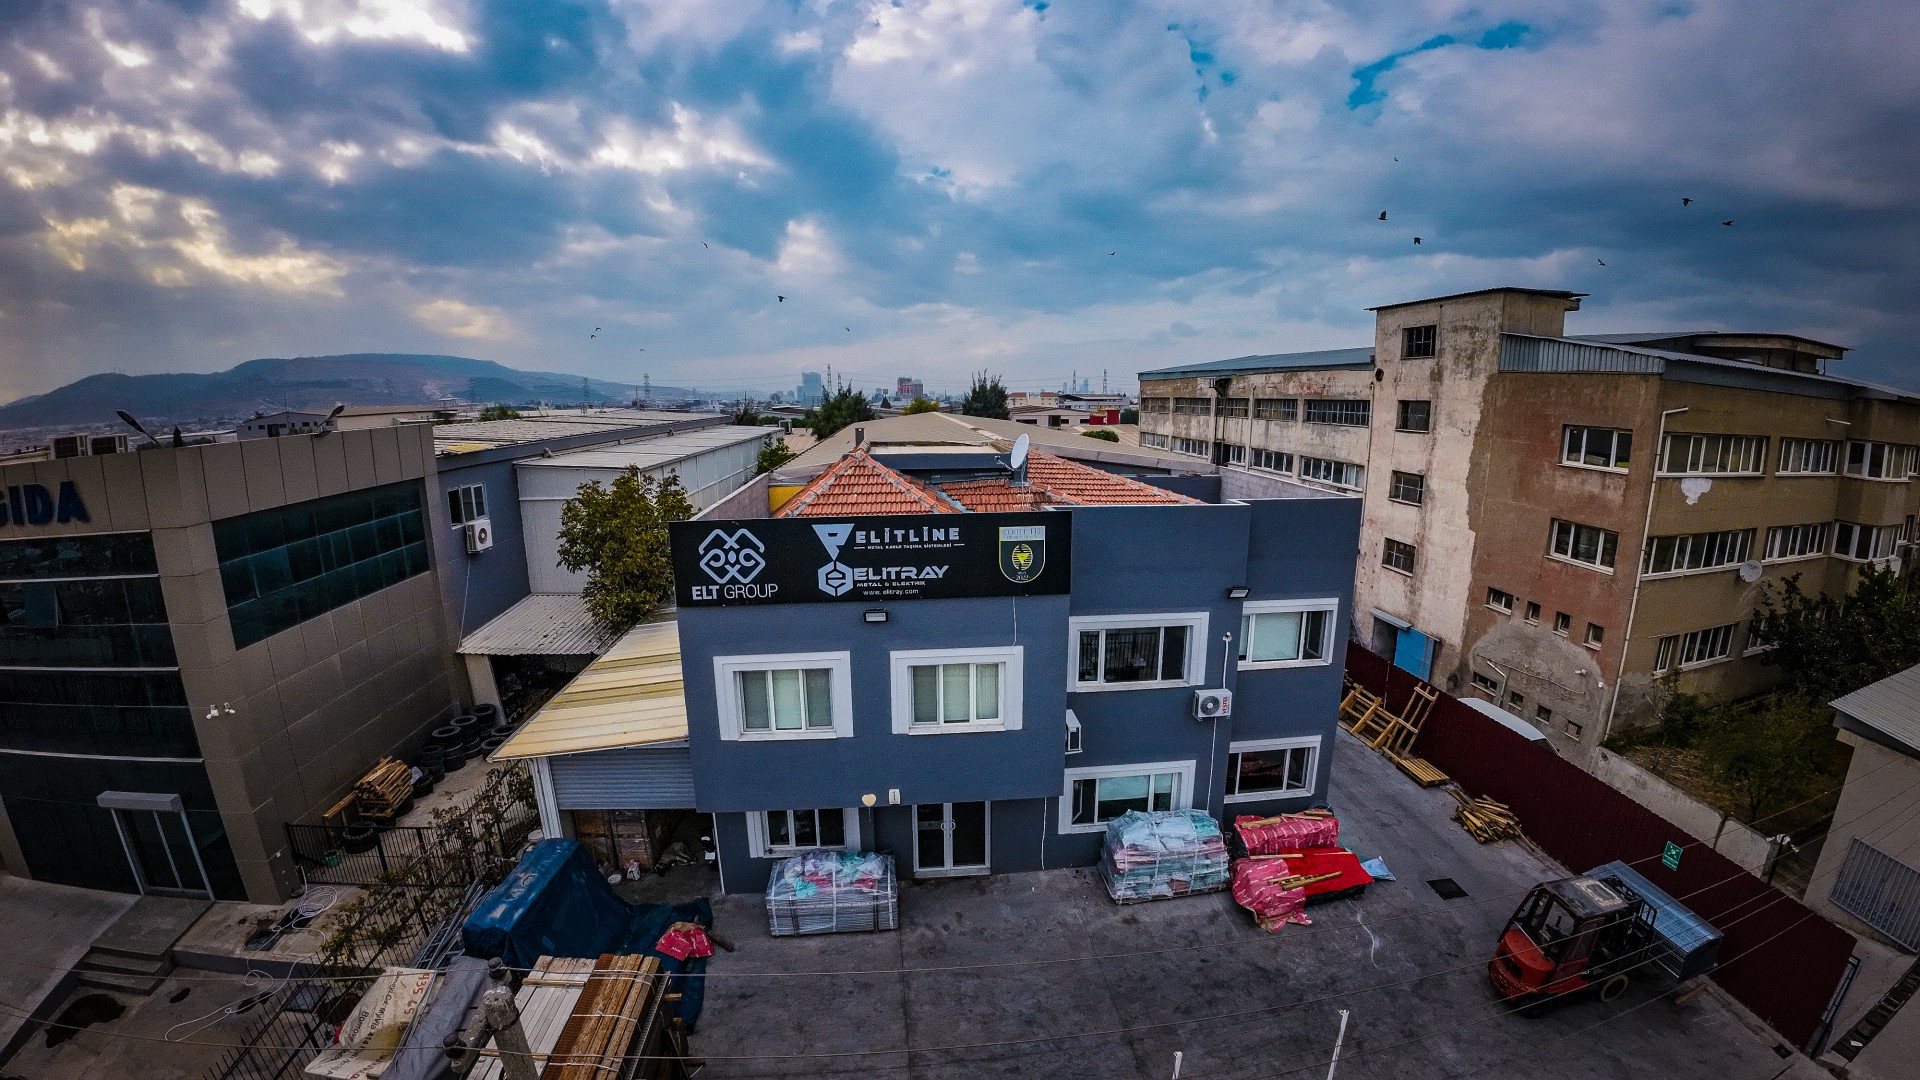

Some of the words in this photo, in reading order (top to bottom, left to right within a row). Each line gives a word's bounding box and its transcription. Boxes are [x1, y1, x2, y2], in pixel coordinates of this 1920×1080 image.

[853, 565, 950, 581] ELITRAY
[691, 585, 720, 600] ELT
[724, 583, 779, 599] GROUP
